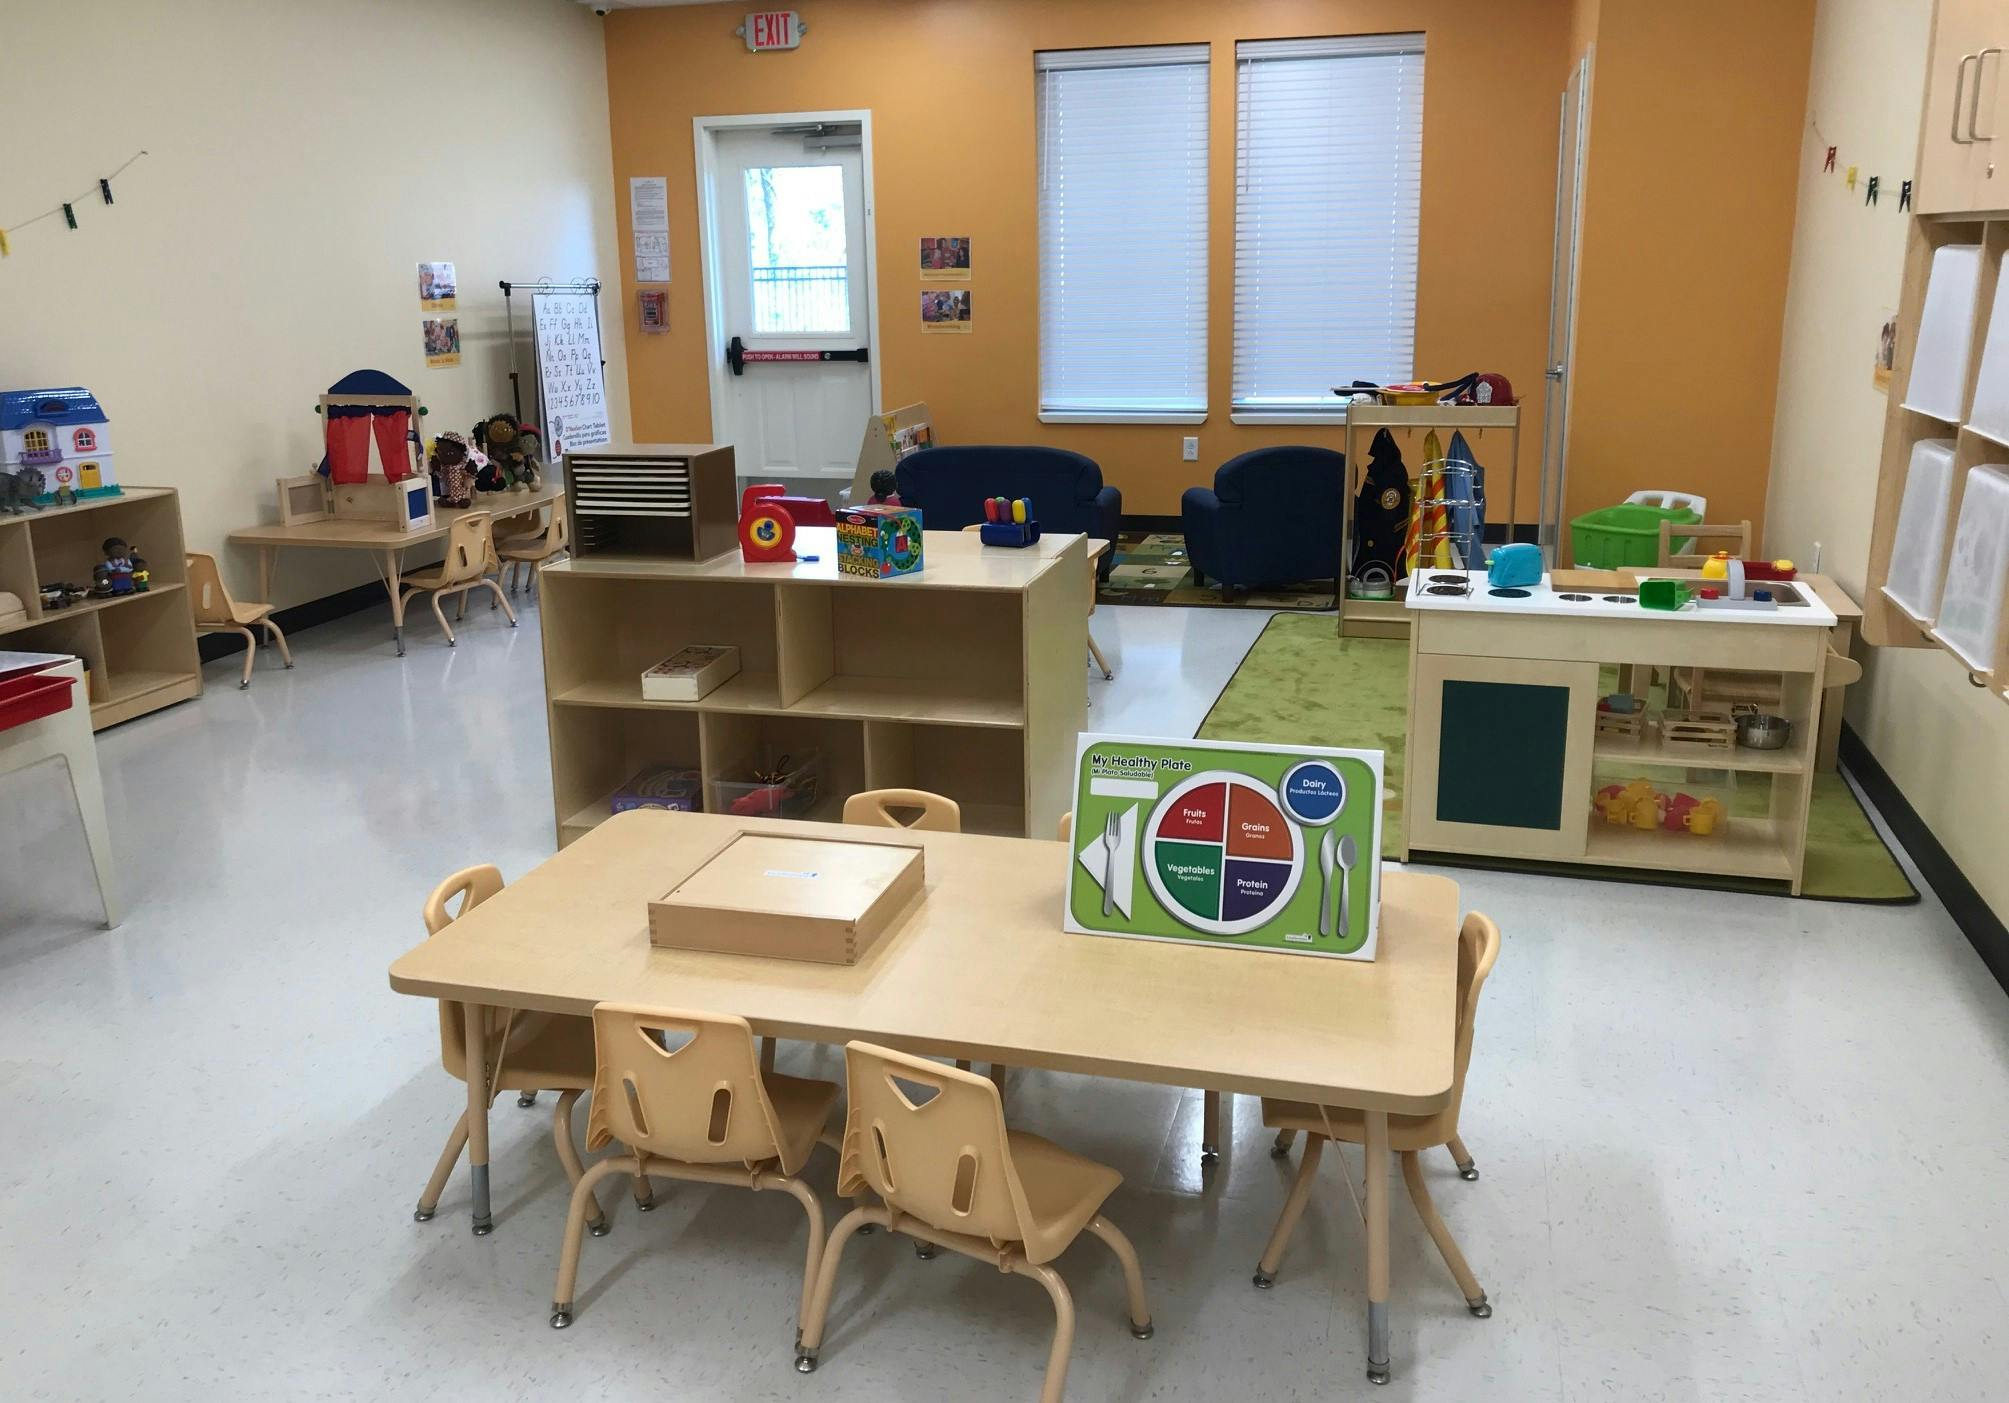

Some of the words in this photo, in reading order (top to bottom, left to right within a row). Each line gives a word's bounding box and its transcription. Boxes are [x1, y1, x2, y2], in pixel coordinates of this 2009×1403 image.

[754, 12, 791, 47] EXIT
[553, 302, 562, 315] Bb
[566, 302, 575, 314] Cc
[578, 302, 588, 314] Dd
[549, 318, 557, 330] Ff
[561, 318, 571, 335] Gg
[574, 318, 583, 330] Hh
[554, 333, 564, 346] Kk
[578, 332, 590, 345] Mm
[557, 349, 567, 361] Oo
[571, 348, 579, 365] Pp
[582, 347, 592, 363] Qq
[565, 364, 573, 377] Tt
[560, 380, 571, 392] Xx
[575, 379, 583, 395] Yy
[586, 378, 596, 390] Zz
[837, 522, 879, 538] ALPHABET
[838, 533, 879, 548] NESTING
[839, 554, 879, 568] STACKING
[838, 563, 880, 579] BLOCKS
[1092, 754, 1108, 767] My
[1111, 755, 1157, 770] Healthy
[1161, 759, 1191, 771] Plate
[1101, 768, 1118, 776] Plato
[1120, 769, 1154, 779] Saludable)
[1302, 779, 1327, 790] Dairy
[1183, 808, 1207, 818] Fruits
[1241, 822, 1270, 833] Grains
[1245, 832, 1265, 840] Granos
[1167, 863, 1215, 875] Vegetables
[1177, 874, 1204, 882] Vegetales
[1237, 878, 1268, 889] Protein
